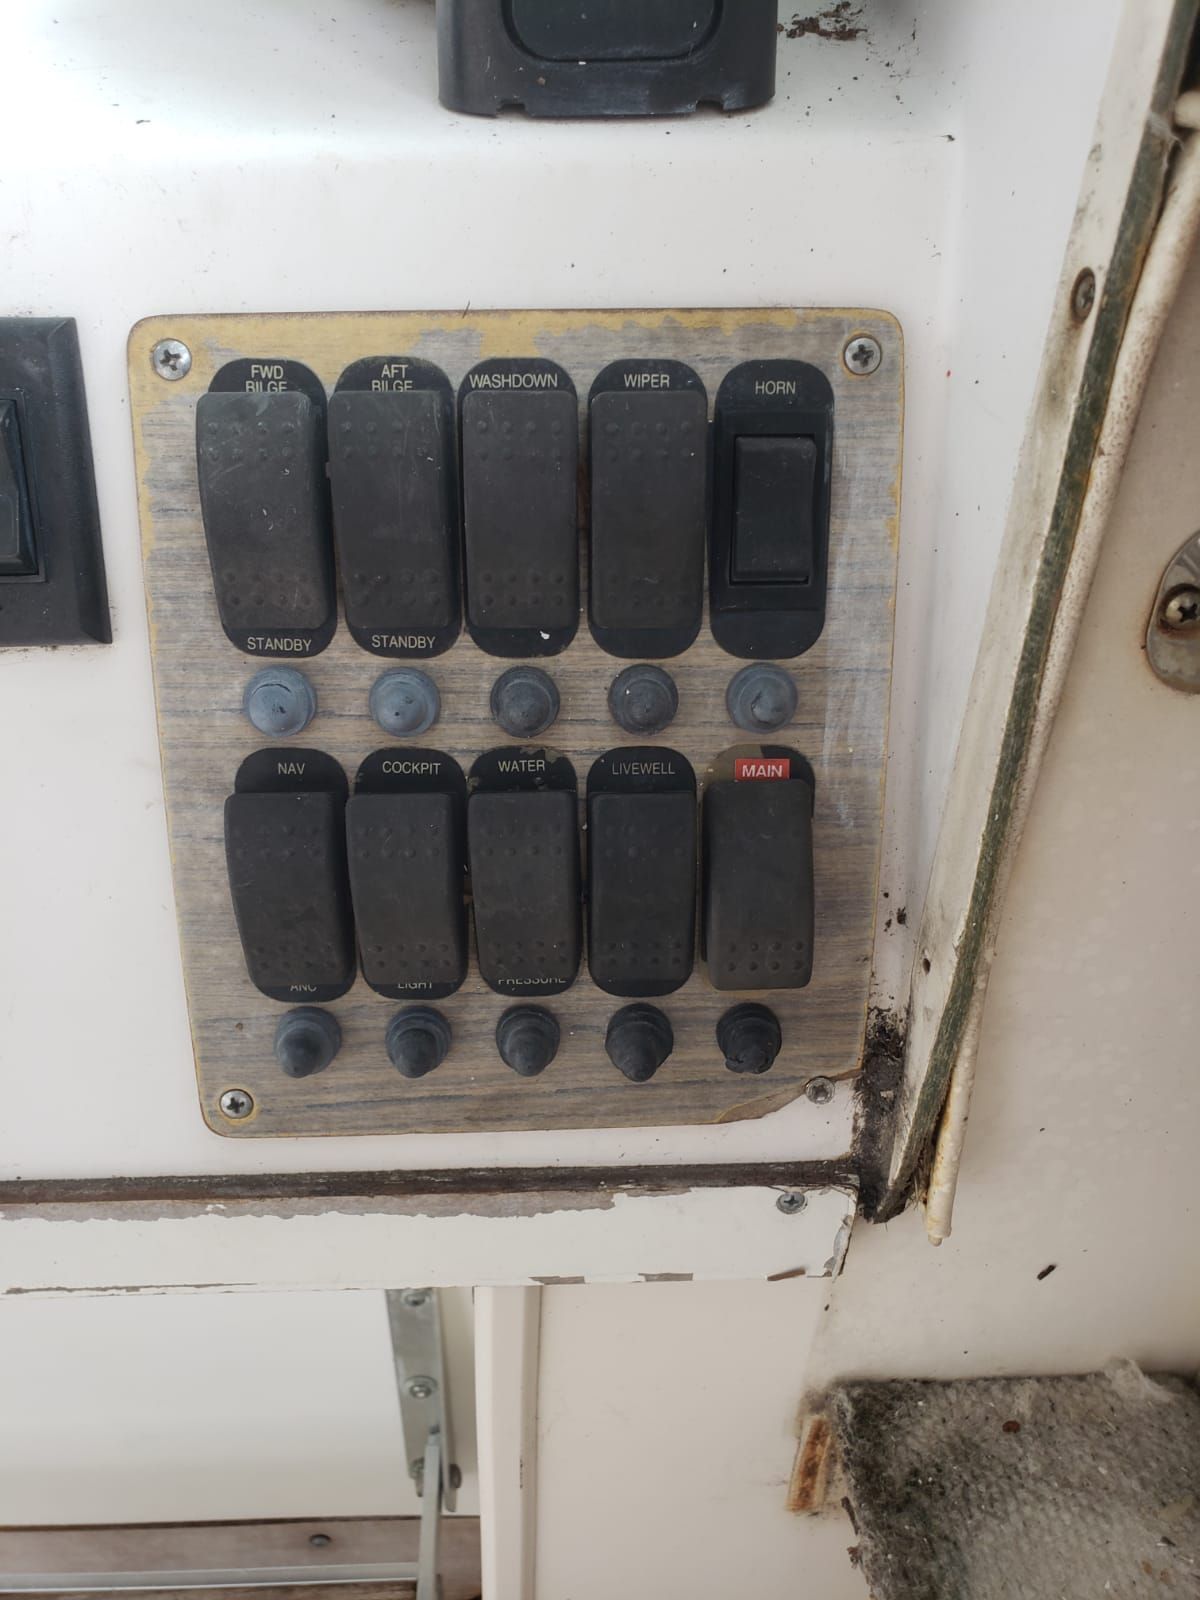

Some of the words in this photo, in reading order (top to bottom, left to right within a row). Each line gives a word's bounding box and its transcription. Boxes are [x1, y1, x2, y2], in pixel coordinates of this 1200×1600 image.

[251, 364, 284, 379] FWD
[381, 364, 408, 378] AFT
[246, 381, 288, 392] BILGE
[372, 380, 413, 392] BILGE
[469, 373, 558, 389] WASHDOWN
[624, 373, 670, 388] WIPER
[755, 380, 796, 395] HORN
[247, 636, 311, 652] STANDBY
[371, 634, 436, 649] STANDBY
[278, 762, 306, 775] NAV
[382, 760, 441, 775] COCKPIT
[498, 759, 546, 772] WATER
[612, 762, 676, 775] LIVEWELL
[742, 764, 783, 778] MAIN
